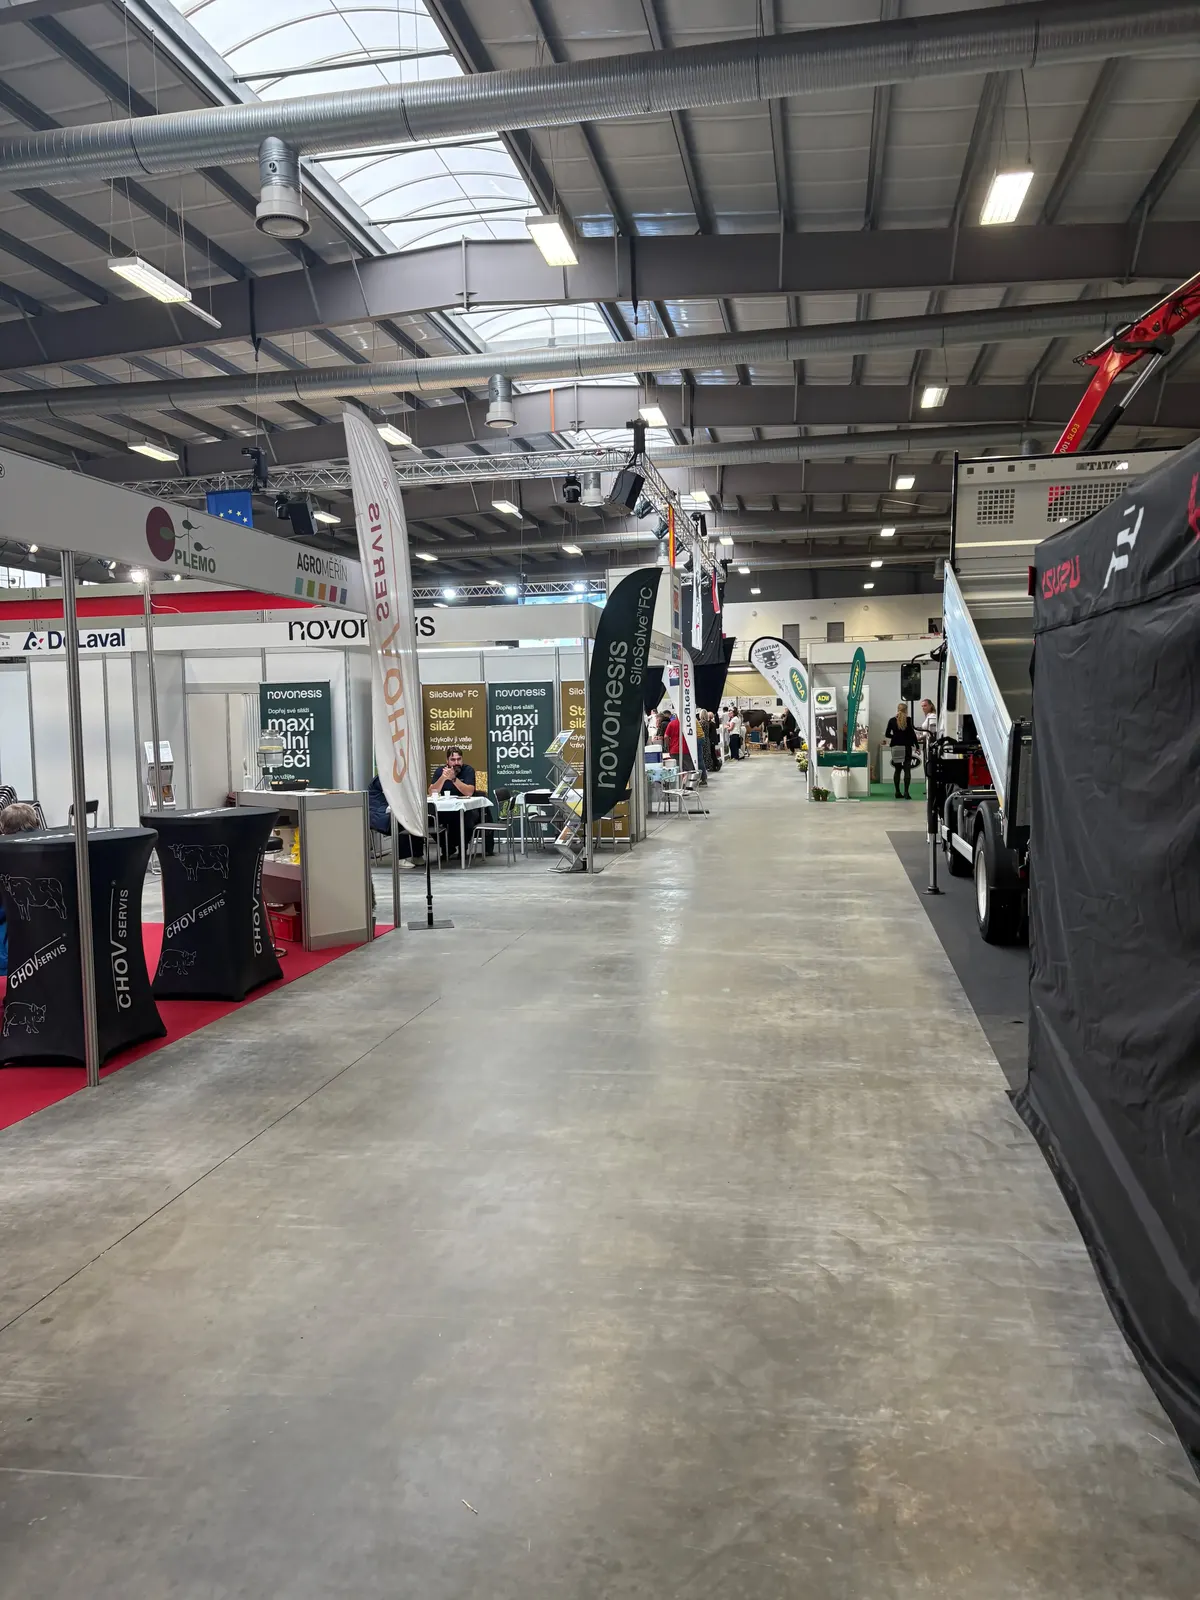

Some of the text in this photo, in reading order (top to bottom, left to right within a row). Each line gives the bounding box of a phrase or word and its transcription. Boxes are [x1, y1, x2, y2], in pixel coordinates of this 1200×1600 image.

[175, 549, 216, 573] PLEMO
[1042, 555, 1081, 600] ISUZU
[640, 587, 653, 608] FC
[48, 628, 126, 649] DLaval
[267, 689, 322, 699] novonesis
[495, 688, 546, 697] novonesis
[268, 713, 314, 731] maxi
[429, 707, 473, 719] Stabilní
[495, 709, 538, 726] maxi
[598, 640, 628, 789] novonesis
[430, 720, 455, 731] siláž
[278, 731, 310, 749] ální
[496, 742, 534, 762] péči
[166, 898, 226, 939] CHOV SERVIS
[252, 897, 263, 955] CHOV
[111, 889, 132, 1009] CHOV SERVIS
[10, 944, 67, 989] CHOV SERVIS
